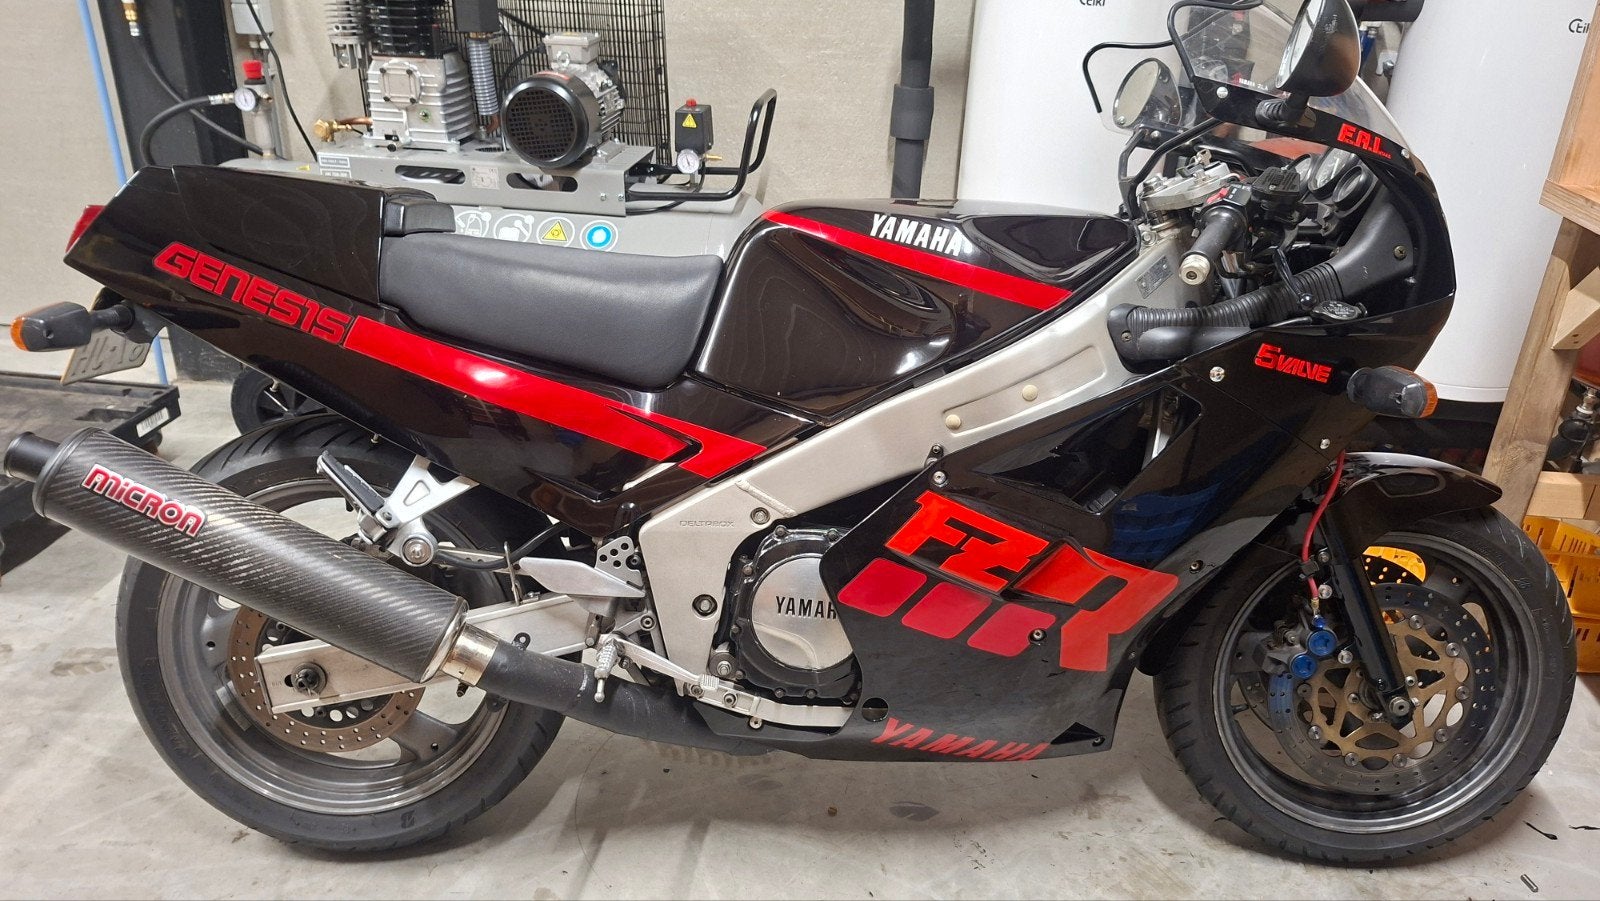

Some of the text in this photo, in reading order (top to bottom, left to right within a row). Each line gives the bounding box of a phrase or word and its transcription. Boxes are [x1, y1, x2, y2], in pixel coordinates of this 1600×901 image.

[869, 213, 961, 257] YAMAHA
[153, 241, 353, 345] GENESIS
[1276, 354, 1333, 384] VALVE
[884, 489, 1179, 672] FZR
[870, 717, 1050, 761] YAMAHA
